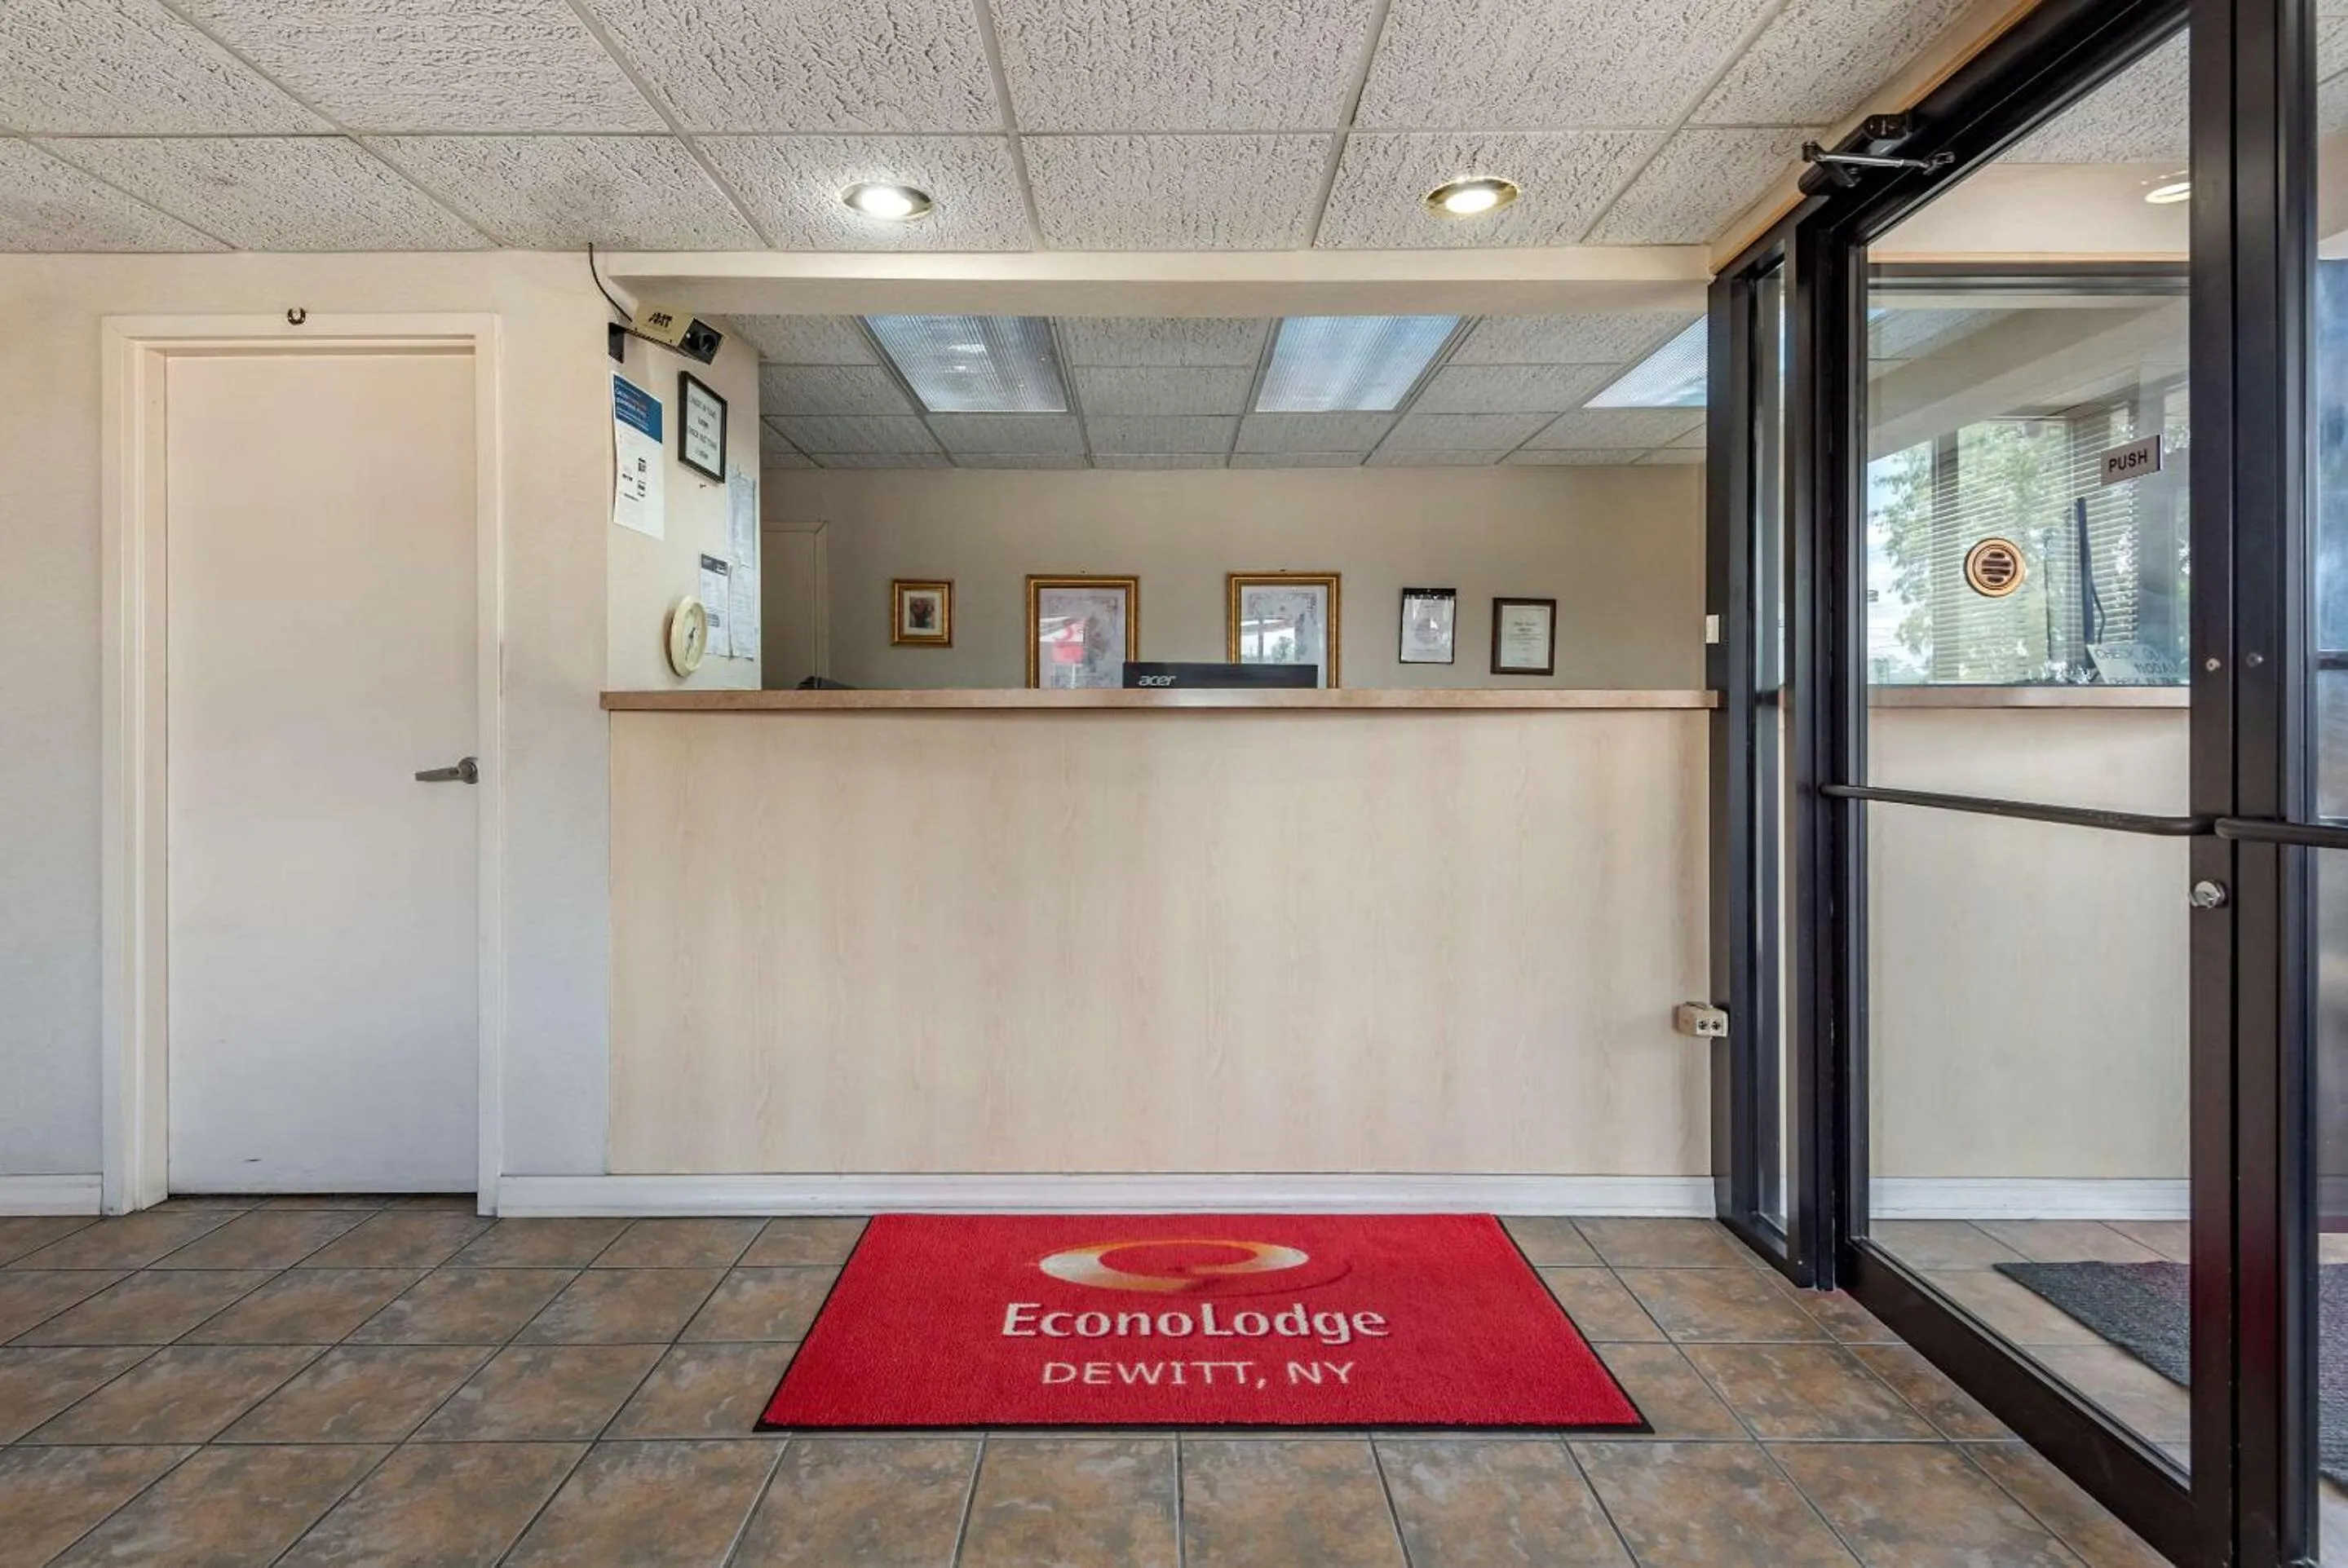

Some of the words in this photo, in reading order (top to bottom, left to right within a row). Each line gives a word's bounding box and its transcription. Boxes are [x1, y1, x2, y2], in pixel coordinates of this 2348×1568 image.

[2109, 448, 2148, 472] PUSH
[1139, 675, 1177, 687] acer
[1002, 1302, 1390, 1345] EconoLodge
[1041, 1362, 1266, 1389] DEWITT,
[1286, 1362, 1355, 1385] NY
